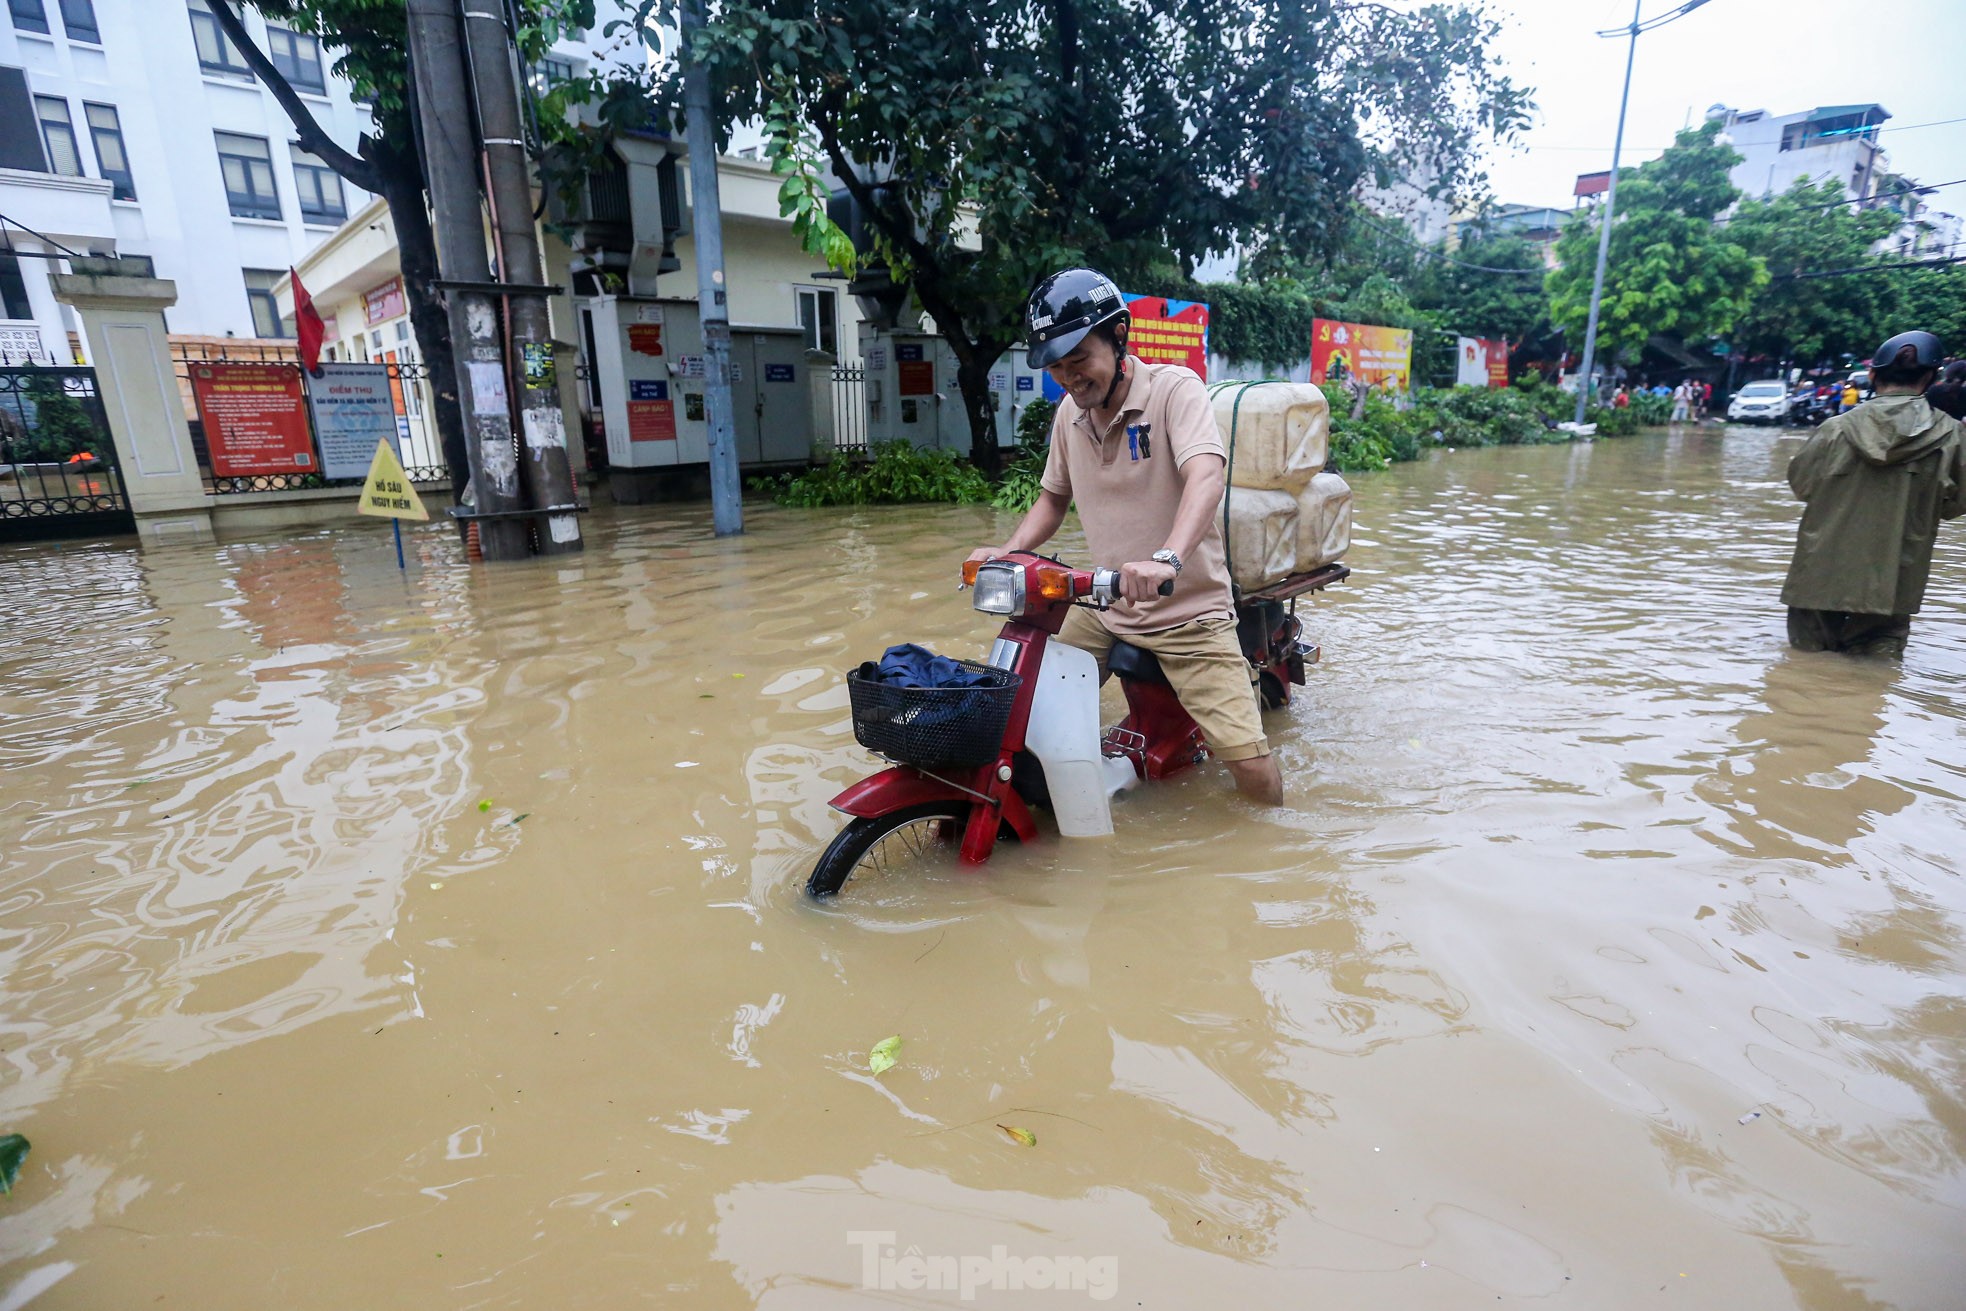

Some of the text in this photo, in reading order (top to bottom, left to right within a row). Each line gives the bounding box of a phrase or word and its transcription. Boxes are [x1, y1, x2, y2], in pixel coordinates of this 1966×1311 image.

[387, 480, 402, 493] SÂU
[371, 495, 411, 510] NGUY HIỂM
